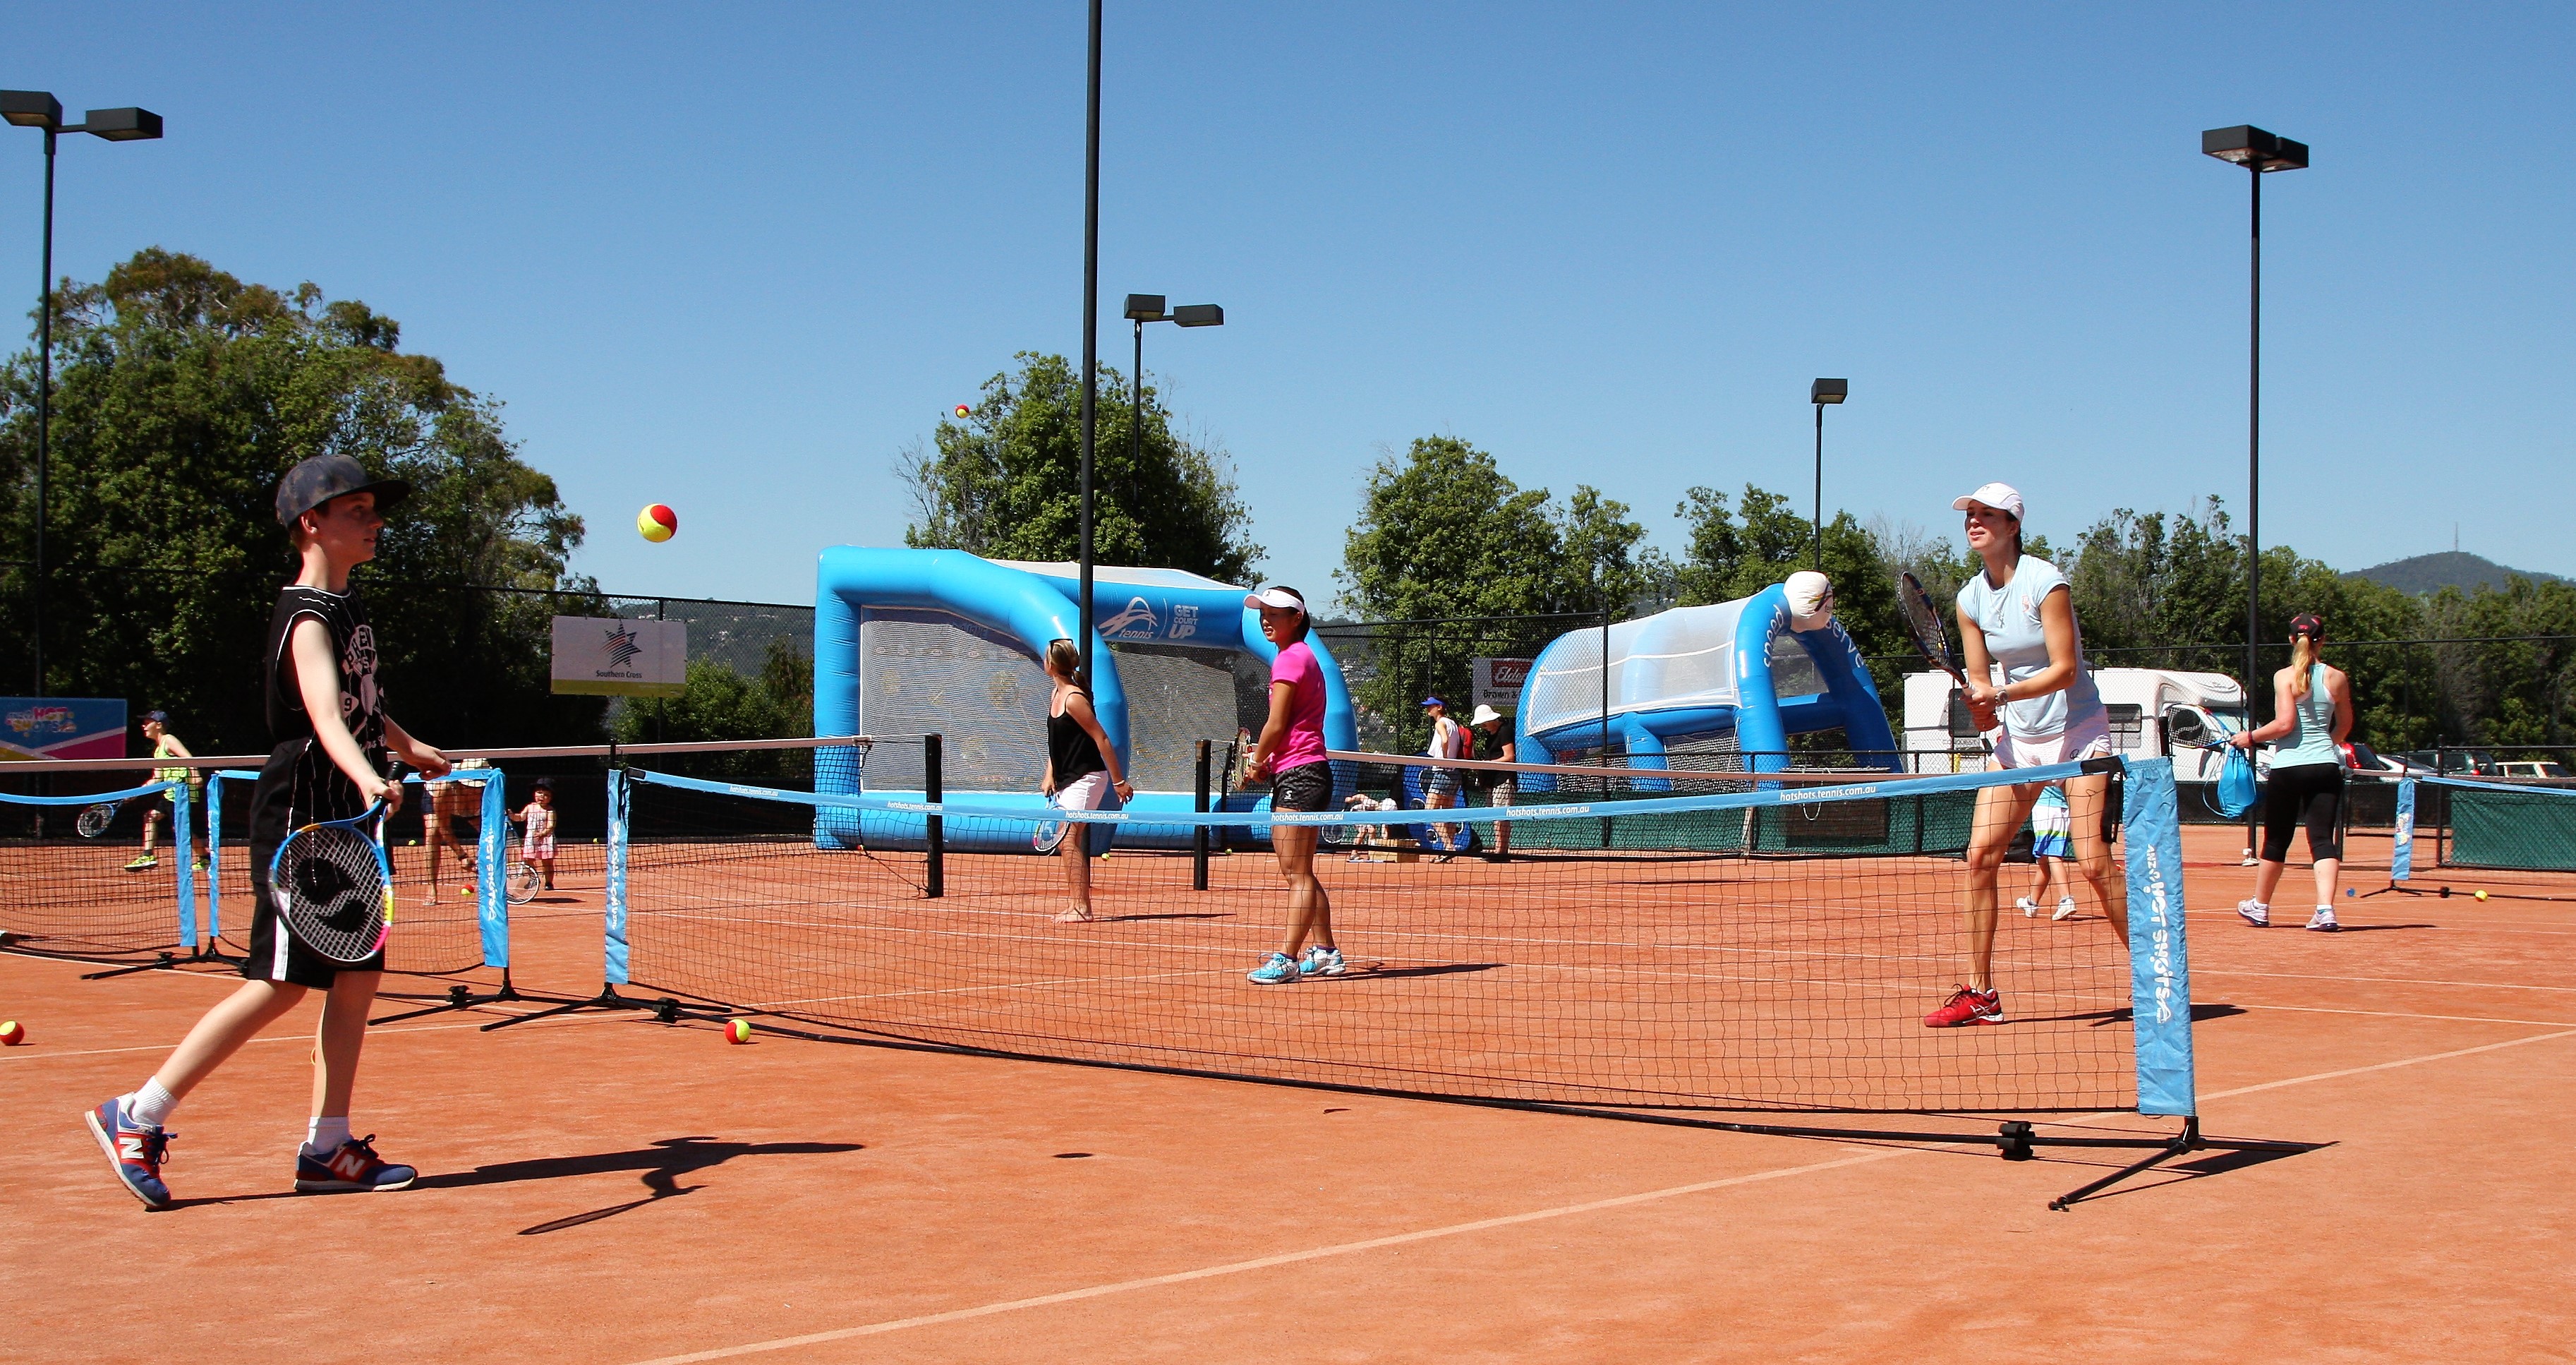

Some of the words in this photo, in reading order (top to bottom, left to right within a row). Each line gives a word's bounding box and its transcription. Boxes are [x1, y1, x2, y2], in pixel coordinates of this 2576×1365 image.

[1173, 604, 1199, 618] GET
[1173, 617, 1198, 625] COURT
[1118, 627, 1154, 639] tennis
[1168, 624, 1197, 639] UP
[1763, 603, 1784, 668] speed
[595, 670, 625, 678] Southern
[1483, 689, 1509, 699] Brown
[344, 697, 352, 712] 9
[1779, 786, 1876, 802] hotshots.tennis.com.au
[1065, 810, 1129, 819] hotshots.tennis.com.au
[1271, 813, 1344, 822] hotshots.tennis.com.au
[1506, 805, 1590, 817] hotshots.tennis.com.au
[2146, 843, 2157, 869] ANZ
[2150, 882, 2167, 927] HOT
[2152, 929, 2171, 1000] SHOTS
[119, 1137, 145, 1159] N
[335, 1154, 365, 1177] N
